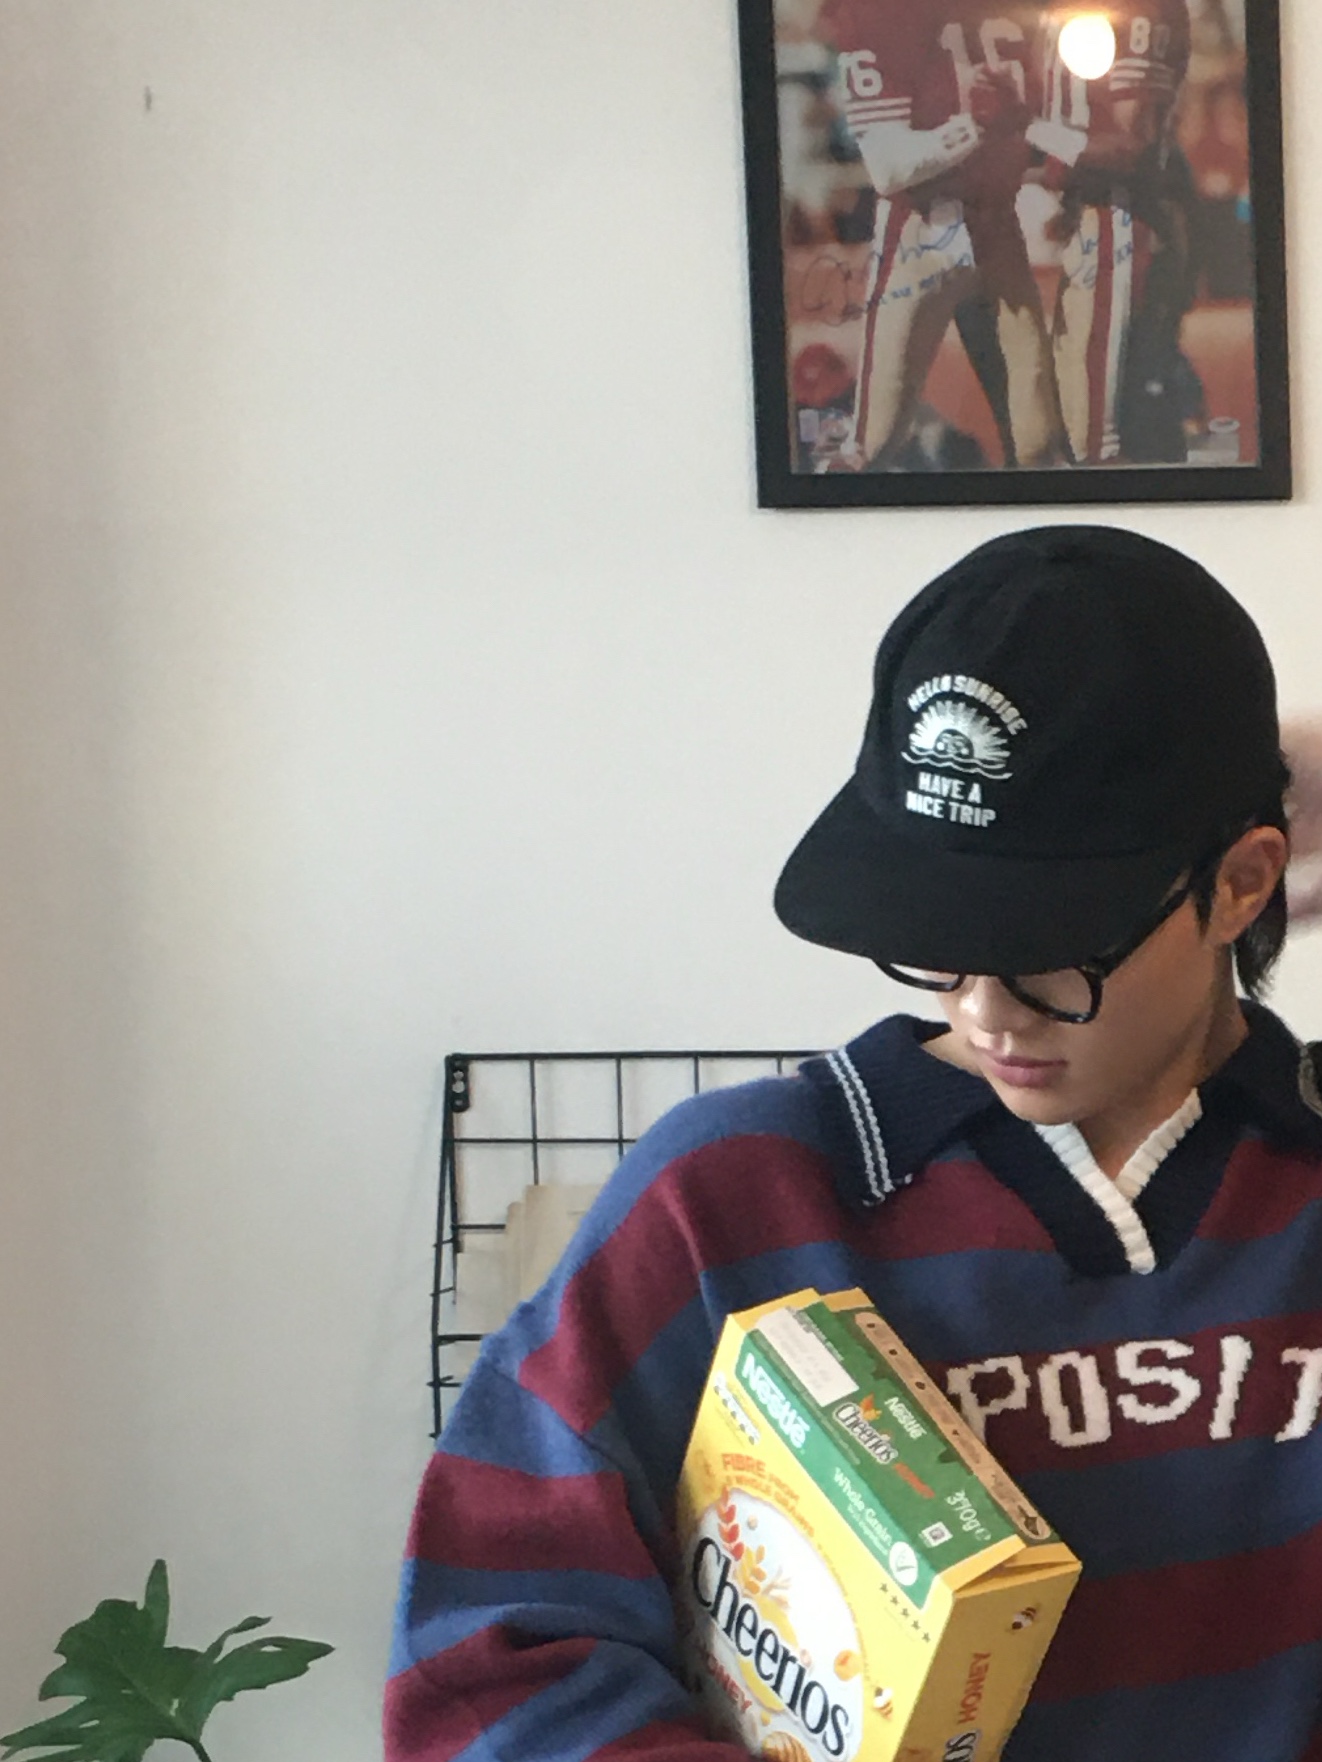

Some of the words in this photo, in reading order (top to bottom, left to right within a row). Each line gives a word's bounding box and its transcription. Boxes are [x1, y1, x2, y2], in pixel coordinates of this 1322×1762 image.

[905, 790, 946, 819] NICE
[949, 801, 997, 828] TRIP
[918, 771, 966, 800] HAVE
[967, 782, 982, 804] A
[834, 1403, 897, 1463] Cheerios
[692, 1536, 850, 1757] Cheerios
[957, 1652, 991, 1726] HONEY
